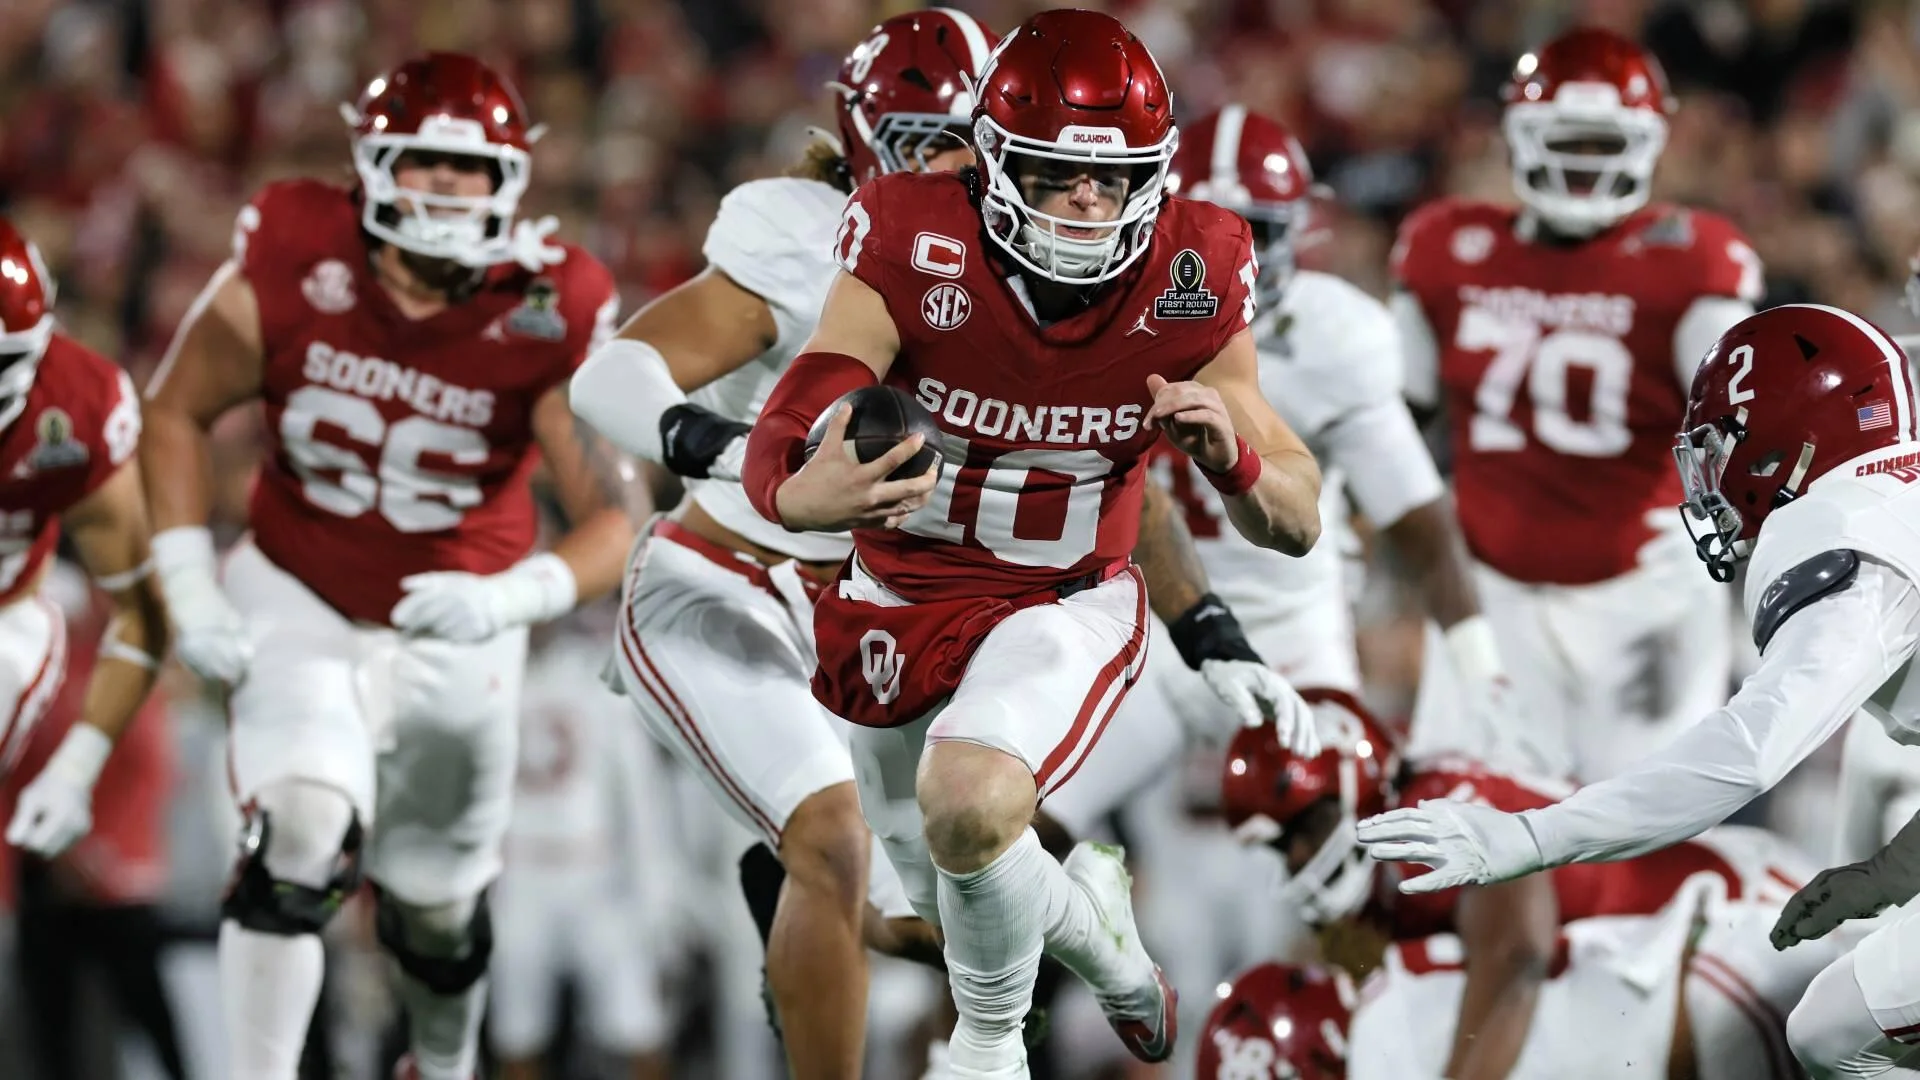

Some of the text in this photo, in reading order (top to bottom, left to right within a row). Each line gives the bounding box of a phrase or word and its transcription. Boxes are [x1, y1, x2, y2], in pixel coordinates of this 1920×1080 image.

[1073, 133, 1113, 144] OKLAHOMA
[914, 235, 961, 276] C
[926, 286, 967, 328] SEC
[1168, 292, 1206, 300] PLAYOFF
[303, 340, 495, 427] SOONERS
[1455, 303, 1634, 457] 70
[1728, 344, 1755, 405] 2
[915, 377, 1142, 443] SOONERS
[280, 385, 487, 532] 66
[898, 431, 1114, 569] 10
[860, 629, 905, 704] OU
